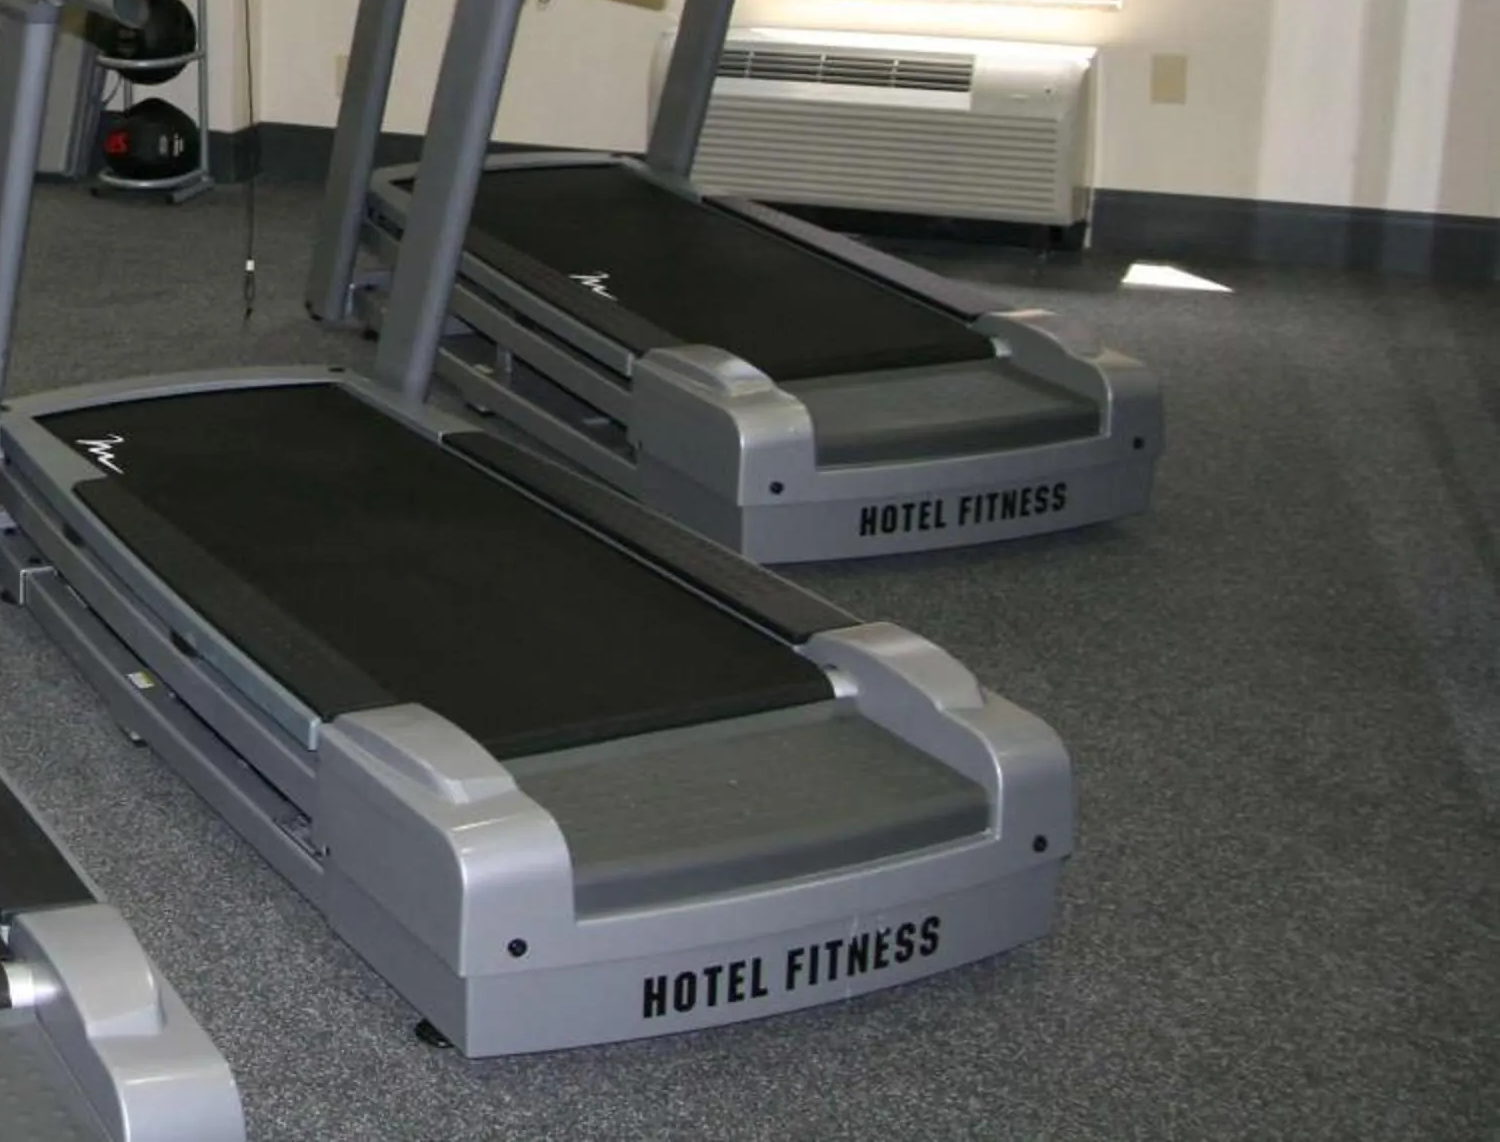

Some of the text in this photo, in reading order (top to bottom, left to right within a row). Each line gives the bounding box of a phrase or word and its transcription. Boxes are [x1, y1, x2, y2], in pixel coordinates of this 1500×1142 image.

[859, 482, 1068, 537] HOTEL FITNESS
[642, 916, 941, 1019] HOTEL FITNESS
